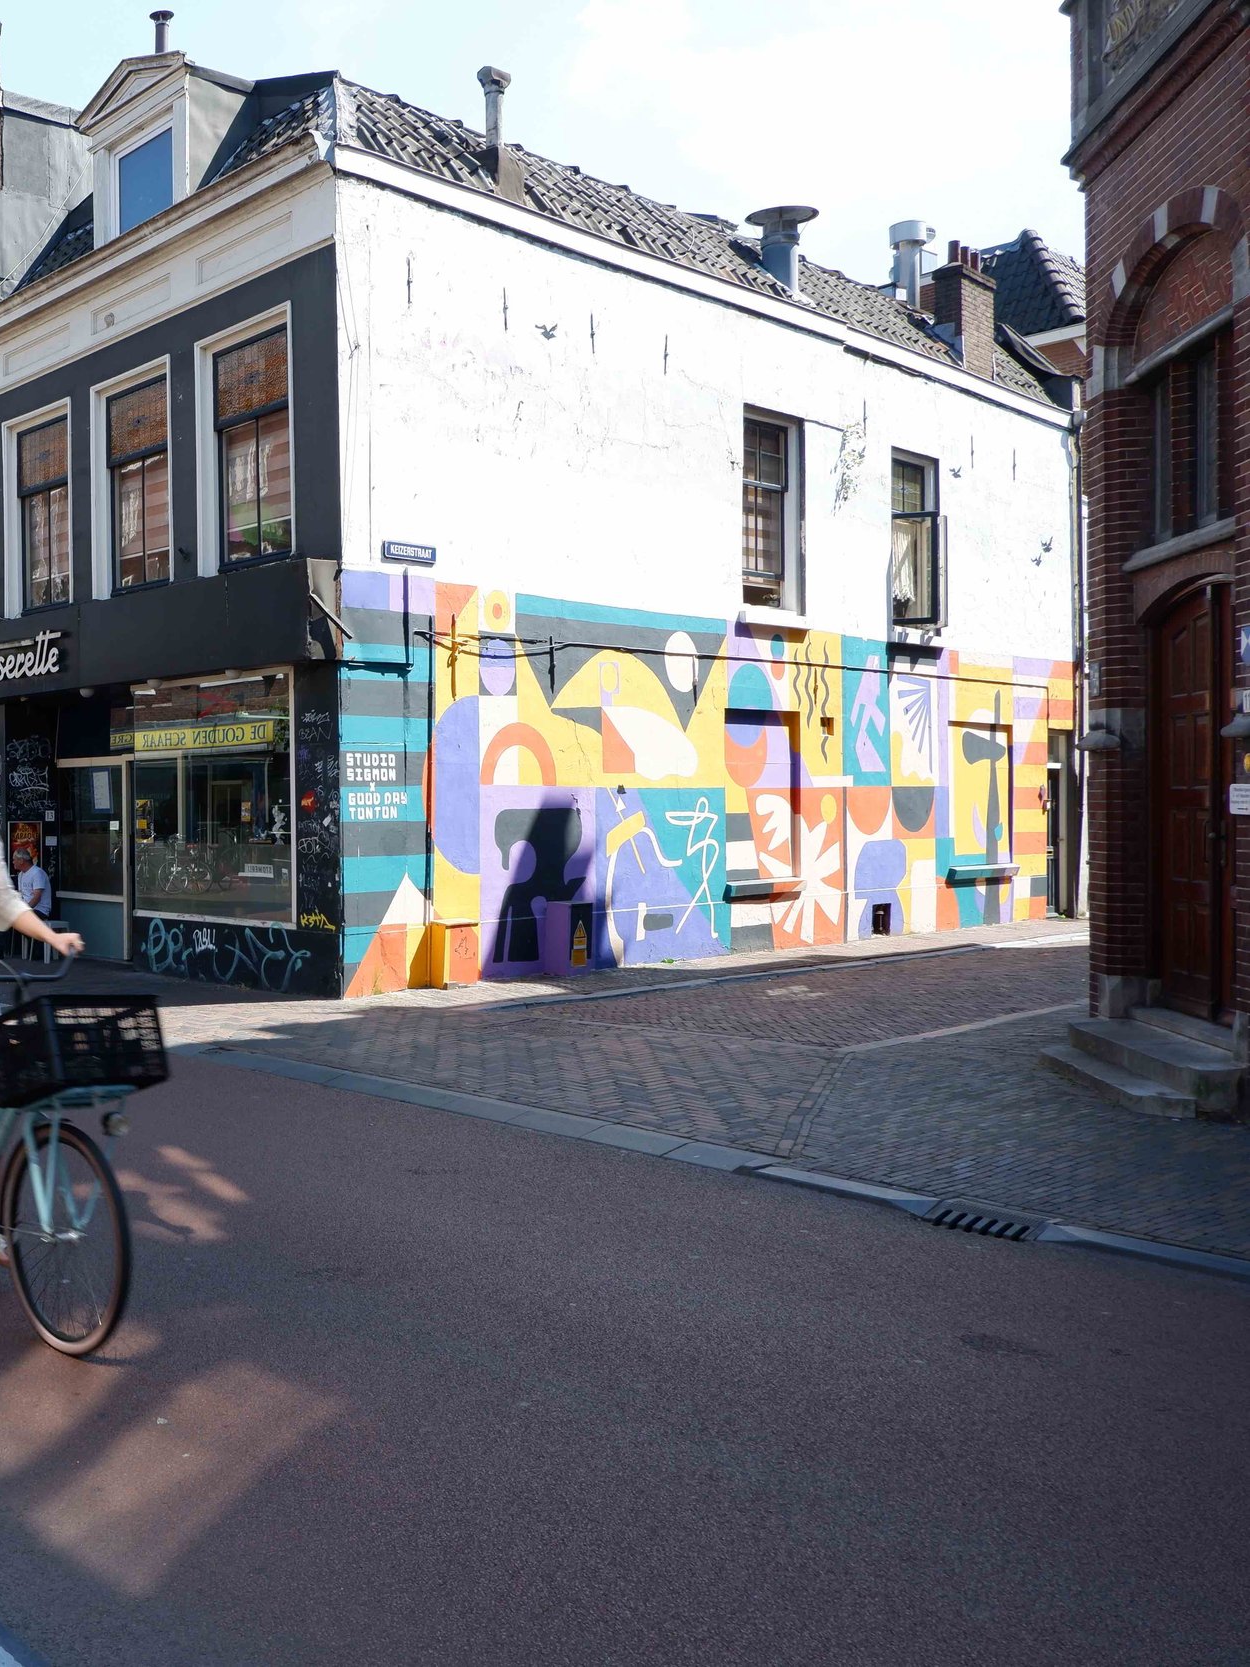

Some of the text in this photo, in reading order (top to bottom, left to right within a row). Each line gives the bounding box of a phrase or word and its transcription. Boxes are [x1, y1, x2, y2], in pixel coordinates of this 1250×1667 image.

[390, 544, 432, 558] KEIZERSTRAAT
[346, 753, 396, 767] STUDIO
[346, 768, 396, 781] SIGMON
[348, 792, 408, 805] GOOD DAY
[349, 806, 398, 820] TONTON
